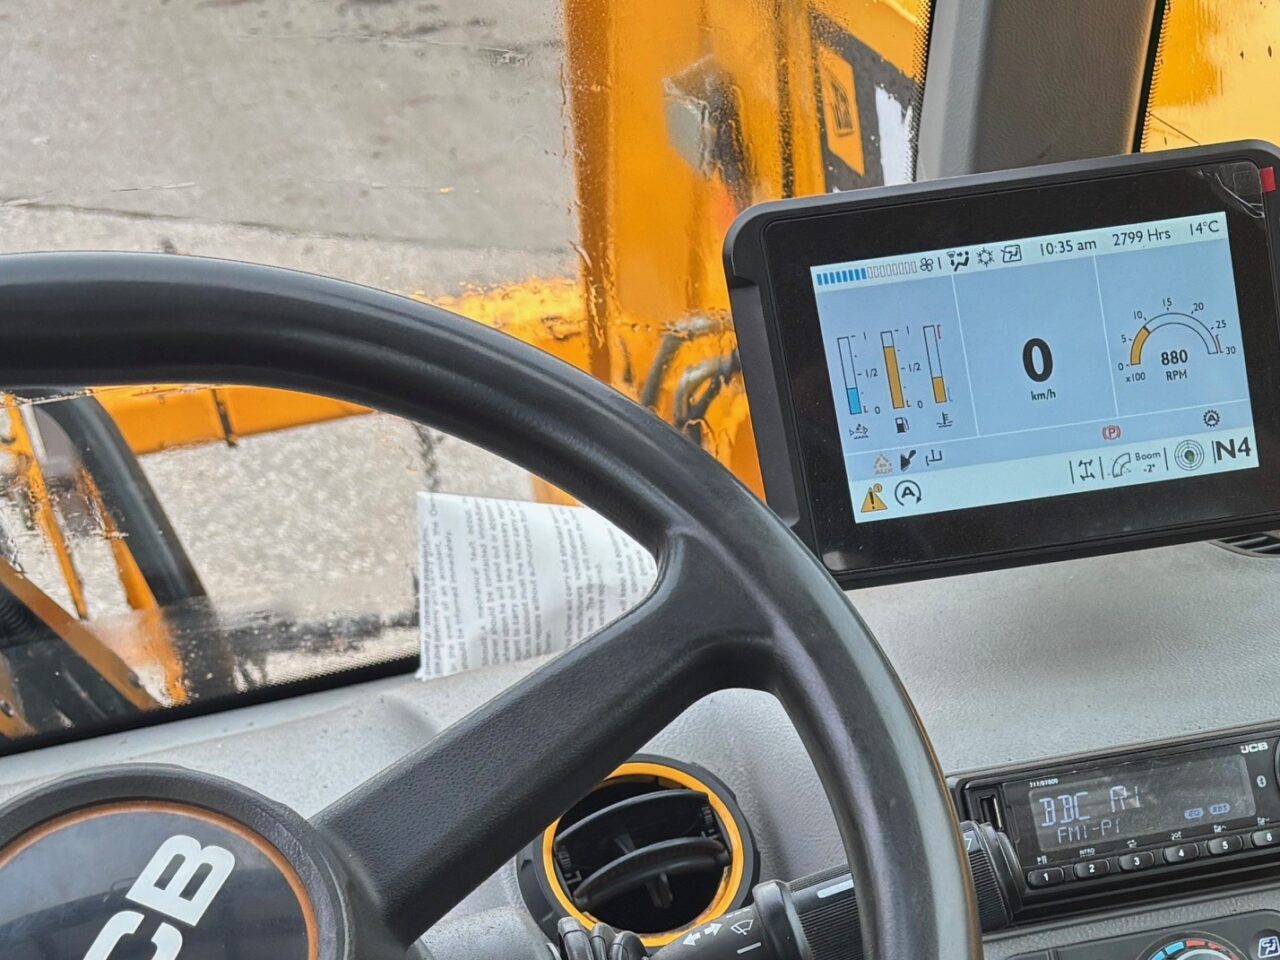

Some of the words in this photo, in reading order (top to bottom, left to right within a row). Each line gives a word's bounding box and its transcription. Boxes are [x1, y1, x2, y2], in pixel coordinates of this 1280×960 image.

[1189, 220, 1220, 237] 14°C
[1112, 230, 1143, 247] 2799
[1147, 228, 1172, 242] Hrs
[1040, 240, 1074, 257] 10:35
[1078, 239, 1098, 252] am
[1162, 298, 1173, 307] 15
[1193, 302, 1204, 312] 20
[1133, 311, 1143, 321] 10
[1216, 320, 1227, 329] 25
[1226, 346, 1236, 355] 30
[1022, 338, 1053, 382] 0
[1161, 350, 1188, 366] 880
[1125, 372, 1146, 382] x100
[1166, 370, 1188, 381] RPM
[1031, 389, 1057, 401] km/h
[1215, 437, 1252, 461] N4
[1135, 452, 1161, 462] Boom
[1240, 741, 1268, 754] JCB
[1266, 833, 1272, 842] 6
[1222, 841, 1229, 850] 5
[1178, 848, 1185, 858] 4
[1133, 857, 1140, 866] 3
[1088, 864, 1095, 873] 2
